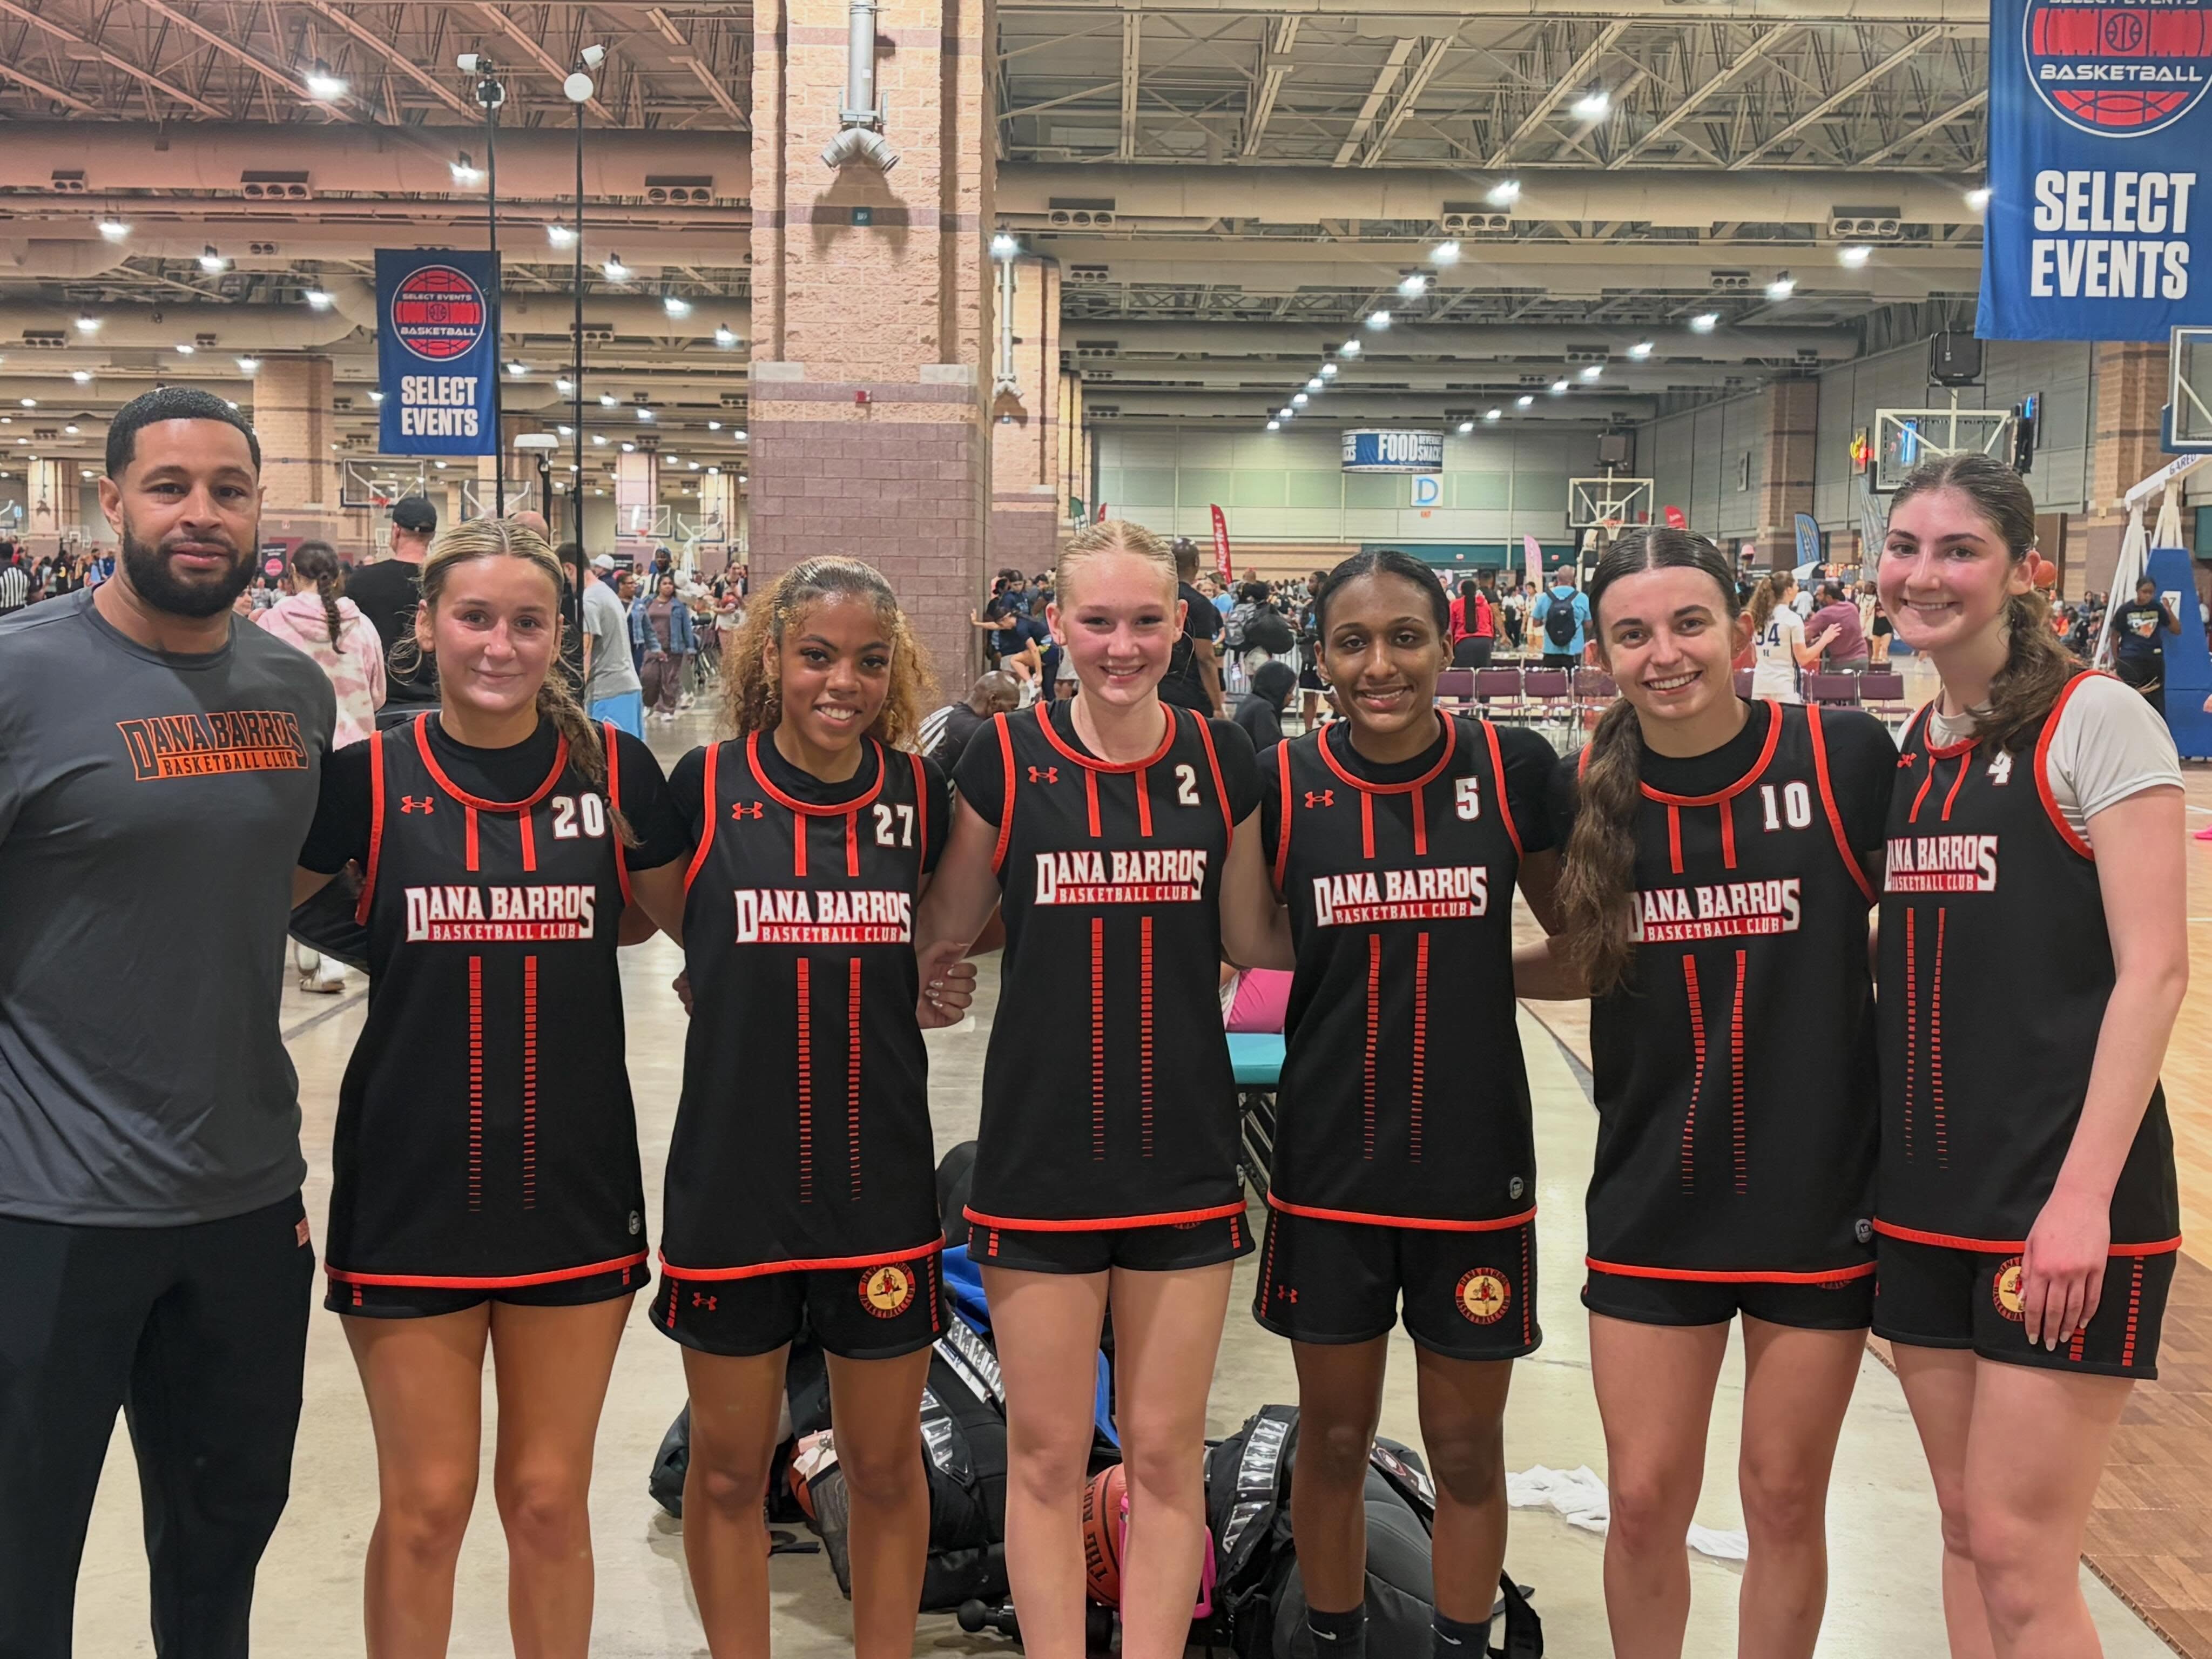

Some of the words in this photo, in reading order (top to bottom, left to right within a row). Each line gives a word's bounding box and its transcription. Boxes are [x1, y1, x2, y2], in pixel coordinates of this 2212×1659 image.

[2040, 64, 2203, 82] BASKETBALL
[2034, 170, 2196, 234] SELECT
[2031, 238, 2190, 300] EVENTS
[400, 327, 477, 336] BASKETBALL
[401, 376, 478, 406] SELECT
[401, 408, 478, 436] EVENTS
[1378, 434, 1418, 461] FOOD
[1415, 477, 1439, 504] D
[116, 714, 212, 781] DANA
[205, 711, 308, 769] BARROS
[164, 752, 260, 775] BASKETBALL
[265, 752, 295, 768] CLUB
[1175, 763, 1201, 806] 2
[1986, 751, 2013, 786] 4
[550, 792, 605, 839] 20
[1454, 775, 1481, 821] 5
[1759, 780, 1813, 832] 10
[873, 802, 914, 847] 27
[1034, 851, 1107, 905] DANA
[1111, 849, 1208, 901] BARROS
[1917, 835, 1998, 892] BARROS
[1947, 874, 1974, 891] CLUB
[404, 886, 486, 942] DANA
[489, 885, 596, 939] BARROS
[1060, 886, 1149, 903] BASKETBALL
[1155, 886, 1188, 900] CLUB
[1313, 872, 1382, 927] DANA
[1385, 866, 1488, 916] BARROS
[1336, 904, 1426, 924] BASKETBALL
[1432, 902, 1467, 917] CLUB
[1628, 888, 1694, 942] DANA
[1695, 878, 1800, 931] BARROS
[433, 923, 534, 940] BASKETBALL
[541, 923, 578, 939] CLUB
[734, 889, 811, 944] DANA
[815, 891, 912, 943] BARROS
[763, 926, 859, 942] BASKETBALL
[864, 926, 897, 941] CLUB
[1648, 919, 1742, 941] BASKETBALL
[1746, 917, 1780, 933] CLUB
